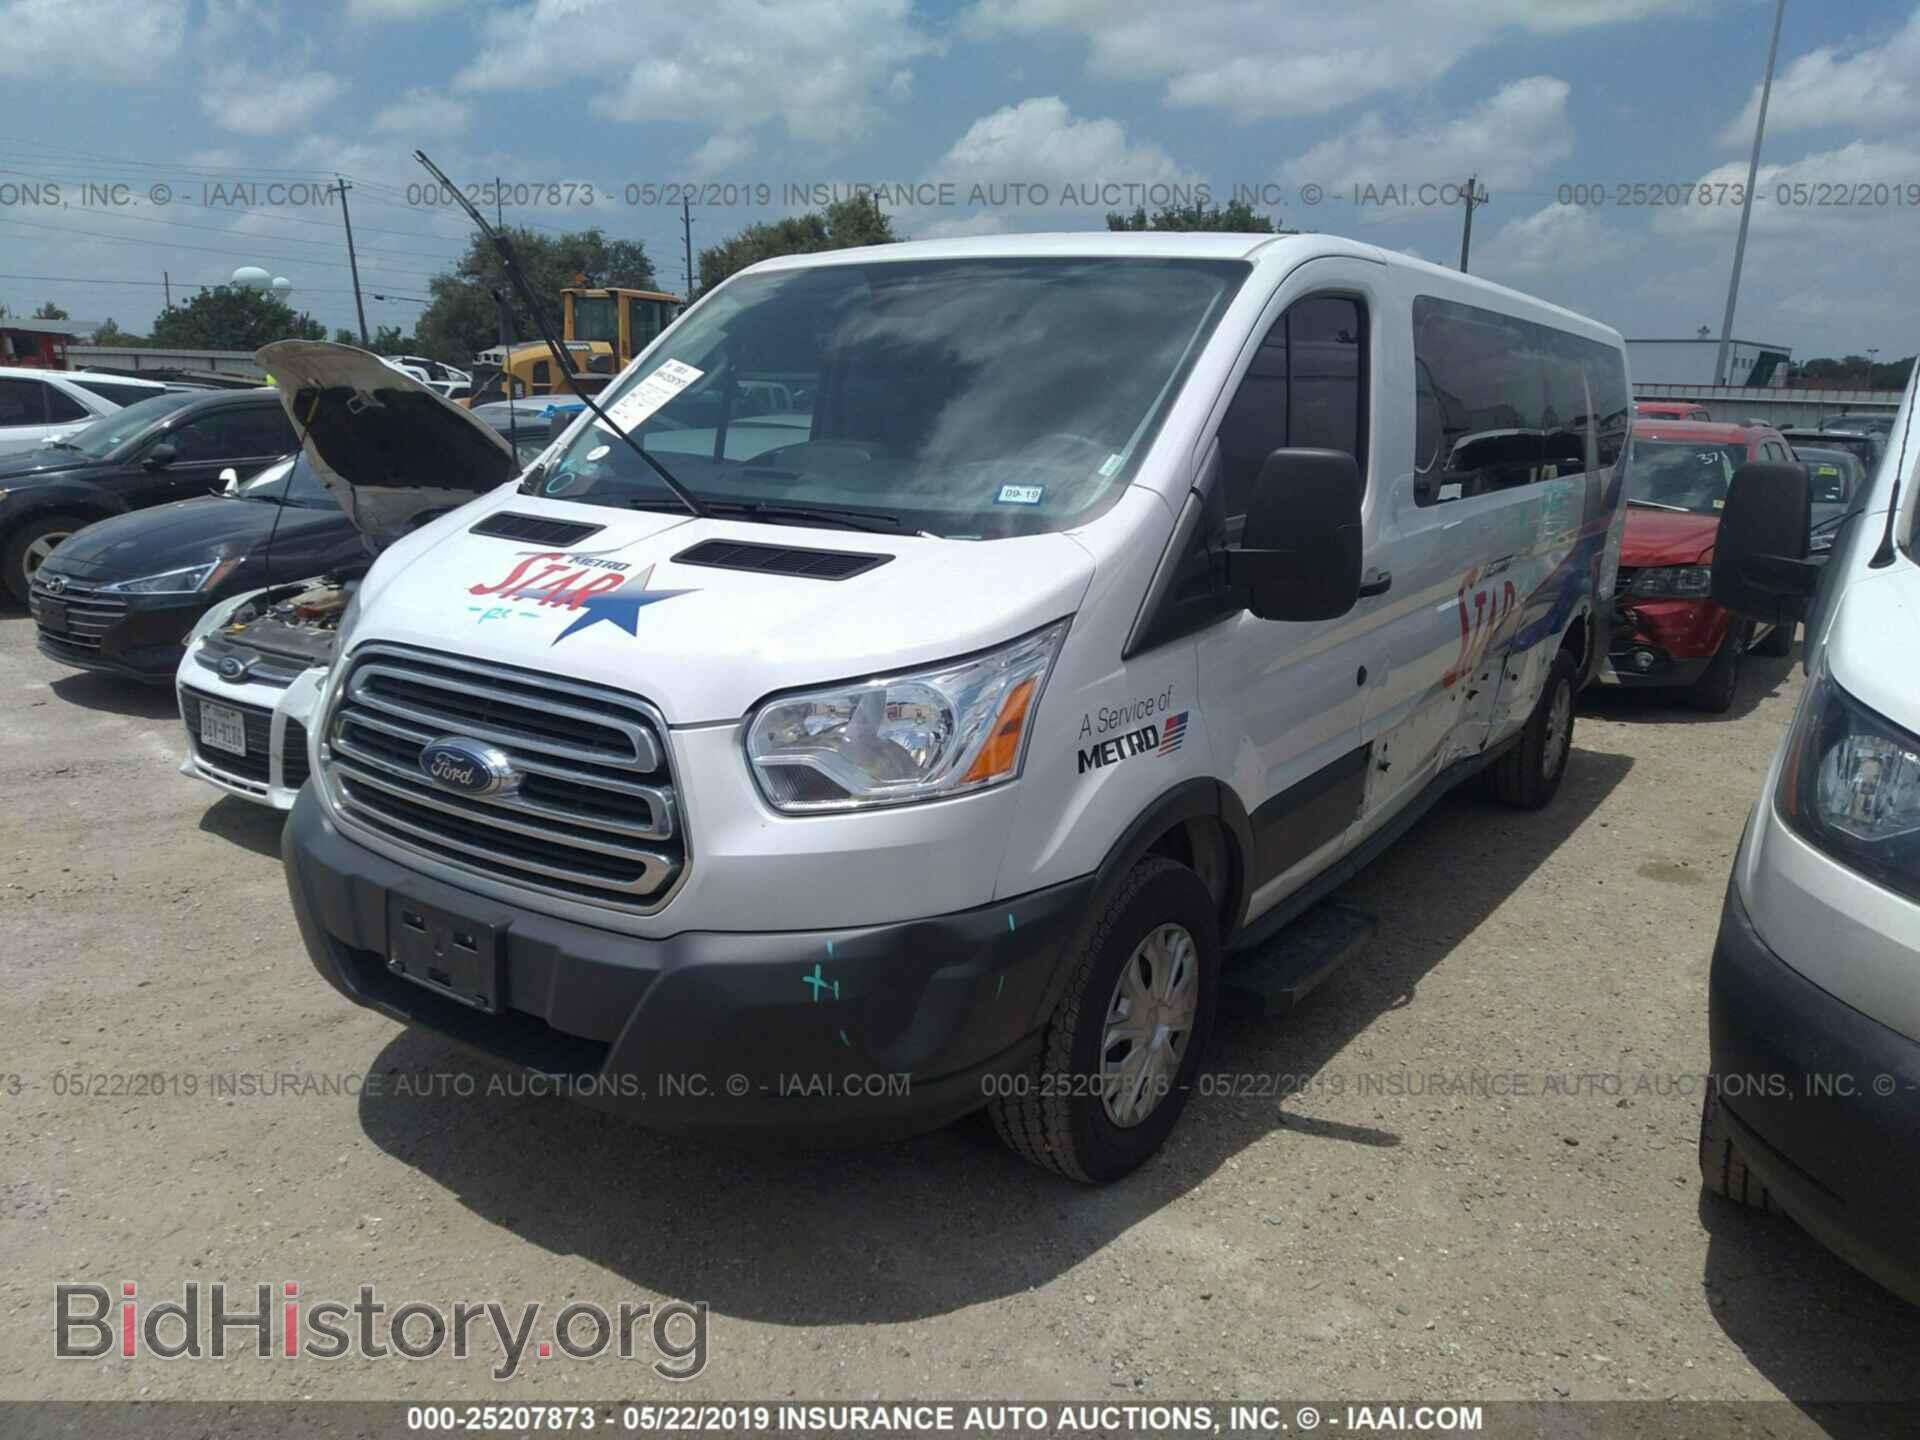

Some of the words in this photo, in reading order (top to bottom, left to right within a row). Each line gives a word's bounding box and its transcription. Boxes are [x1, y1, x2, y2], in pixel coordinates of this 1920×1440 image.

[468, 552, 625, 611] STAR
[568, 556, 632, 572] METRO
[1079, 713, 1092, 740] A
[1097, 697, 1155, 734] Service
[1158, 684, 1175, 712] of
[431, 751, 474, 785] Ford
[1078, 724, 1160, 775] METRO
